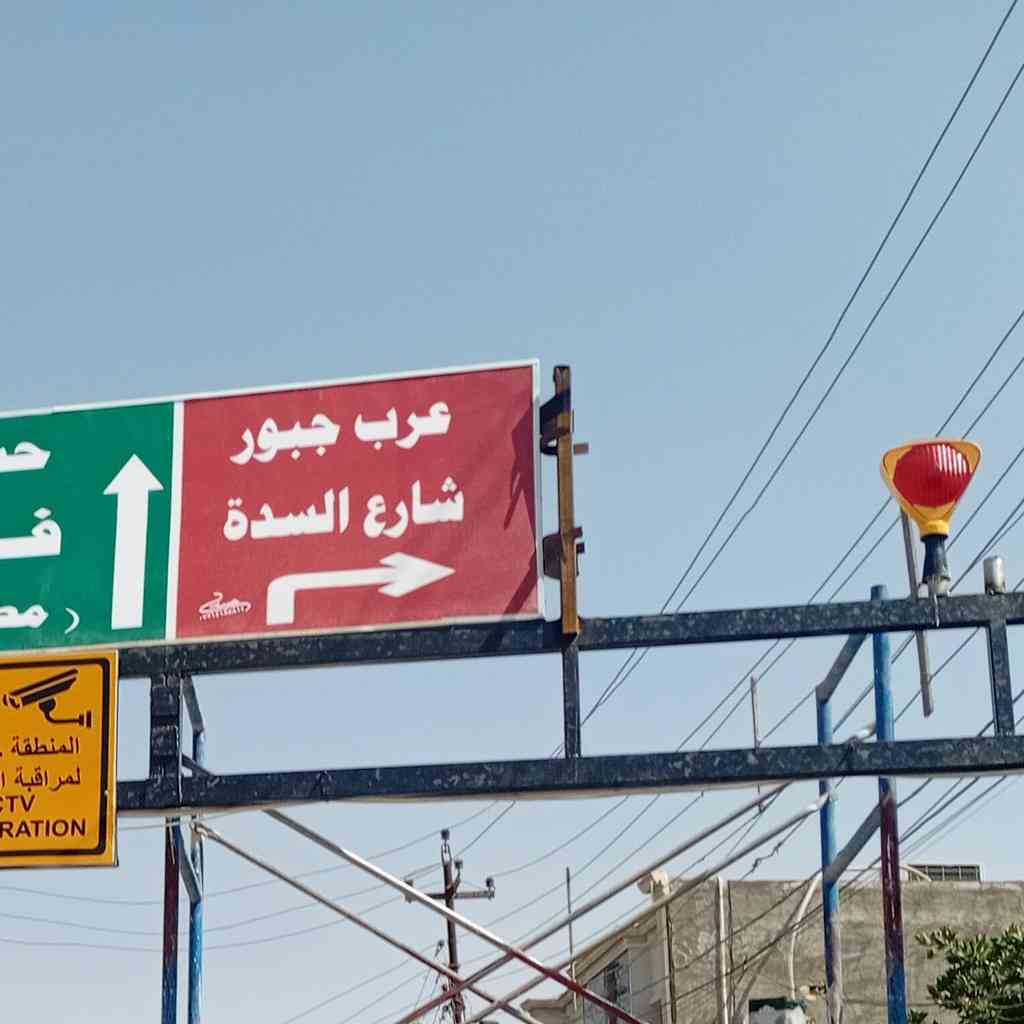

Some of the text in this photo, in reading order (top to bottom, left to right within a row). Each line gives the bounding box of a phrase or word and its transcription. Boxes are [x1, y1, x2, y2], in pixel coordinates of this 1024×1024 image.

[229, 401, 452, 465] عرب جبور
[223, 476, 465, 541] شارع السدة
[10, 735, 80, 758] المنطقة
[14, 765, 81, 793] لمراقبة
